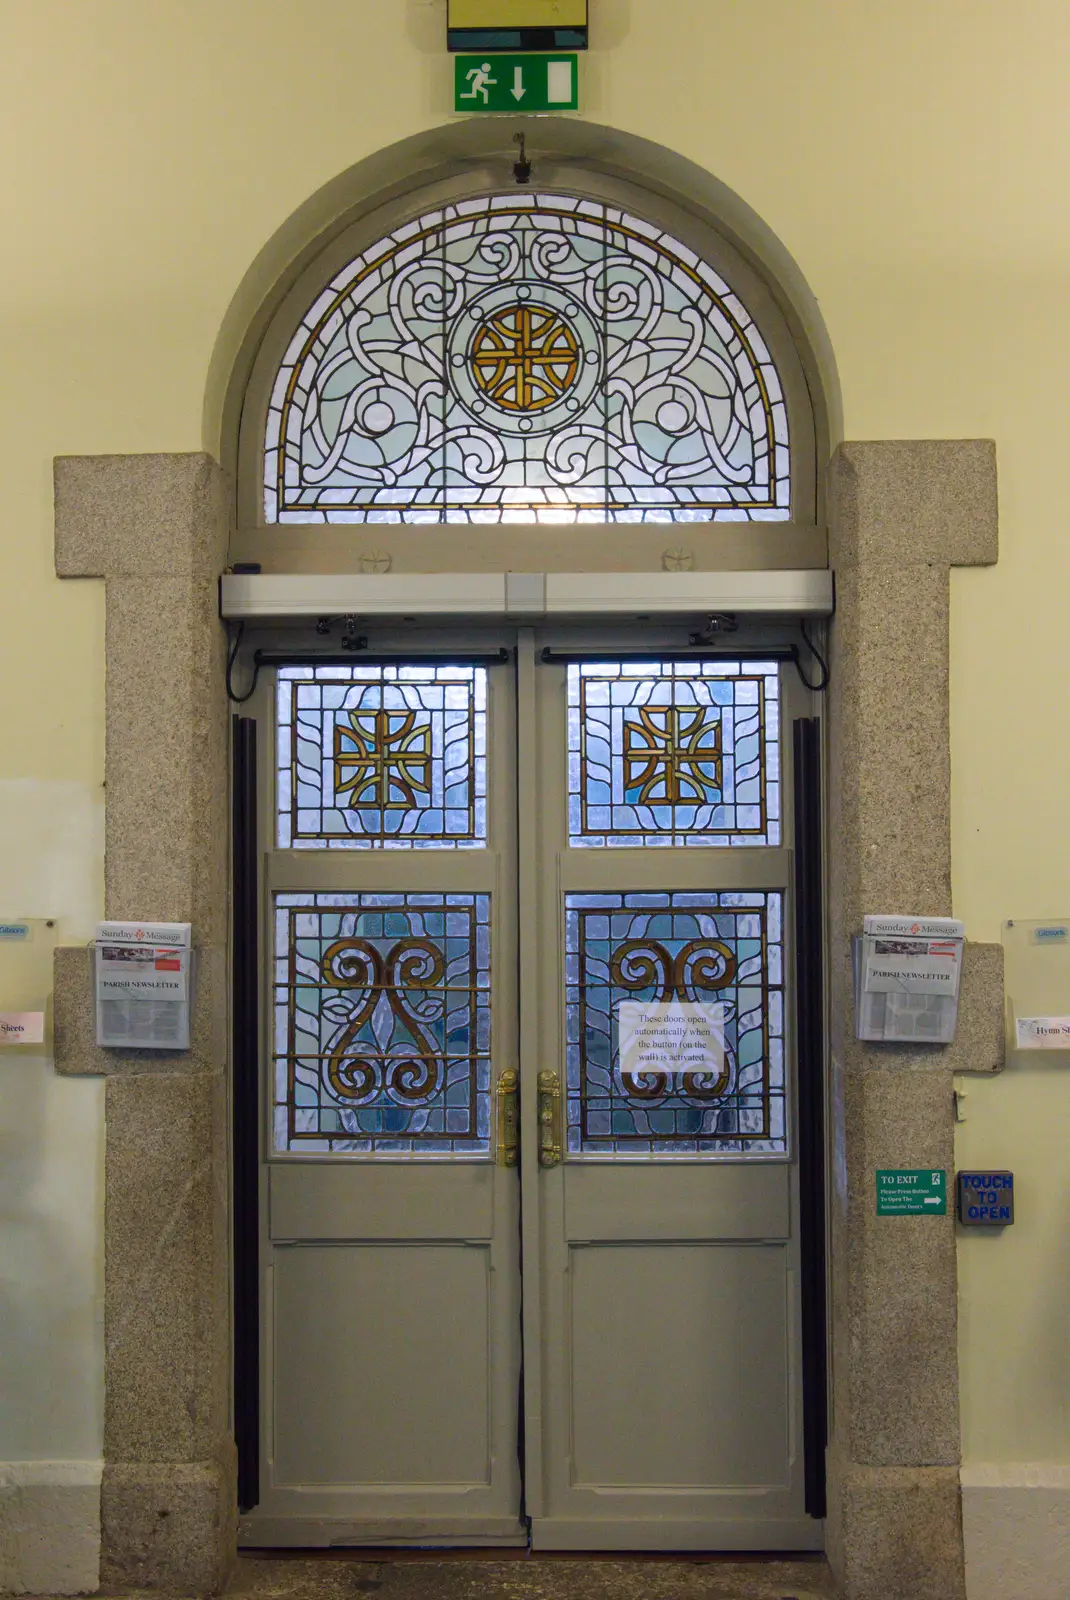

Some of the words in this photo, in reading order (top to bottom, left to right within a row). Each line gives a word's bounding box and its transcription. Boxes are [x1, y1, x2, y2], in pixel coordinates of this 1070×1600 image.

[876, 923, 908, 933] Sunday
[921, 925, 958, 935] Message
[101, 929, 134, 940] Sunday
[146, 931, 181, 942] Message
[872, 971, 900, 980] PARISH
[900, 972, 951, 981] NEWSLETTER
[103, 980, 131, 988] PARISH
[131, 981, 180, 989] NEWSLETTER
[639, 1014, 662, 1023] These
[663, 1015, 686, 1023] doors
[687, 1017, 707, 1025] open
[1, 1024, 25, 1032] Sheets
[634, 1027, 687, 1037] automatically
[689, 1028, 711, 1036] when
[1036, 1026, 1060, 1036] Hymn
[638, 1040, 651, 1048] the
[652, 1040, 677, 1048] button
[694, 1041, 707, 1049] the
[660, 1054, 668, 1062] is
[669, 1054, 705, 1062] activated
[881, 1175, 895, 1184] TO
[897, 1175, 919, 1184] EXIT
[962, 1175, 1012, 1189] TOUCH
[977, 1191, 998, 1204] TO
[968, 1206, 1011, 1220] OPEN
